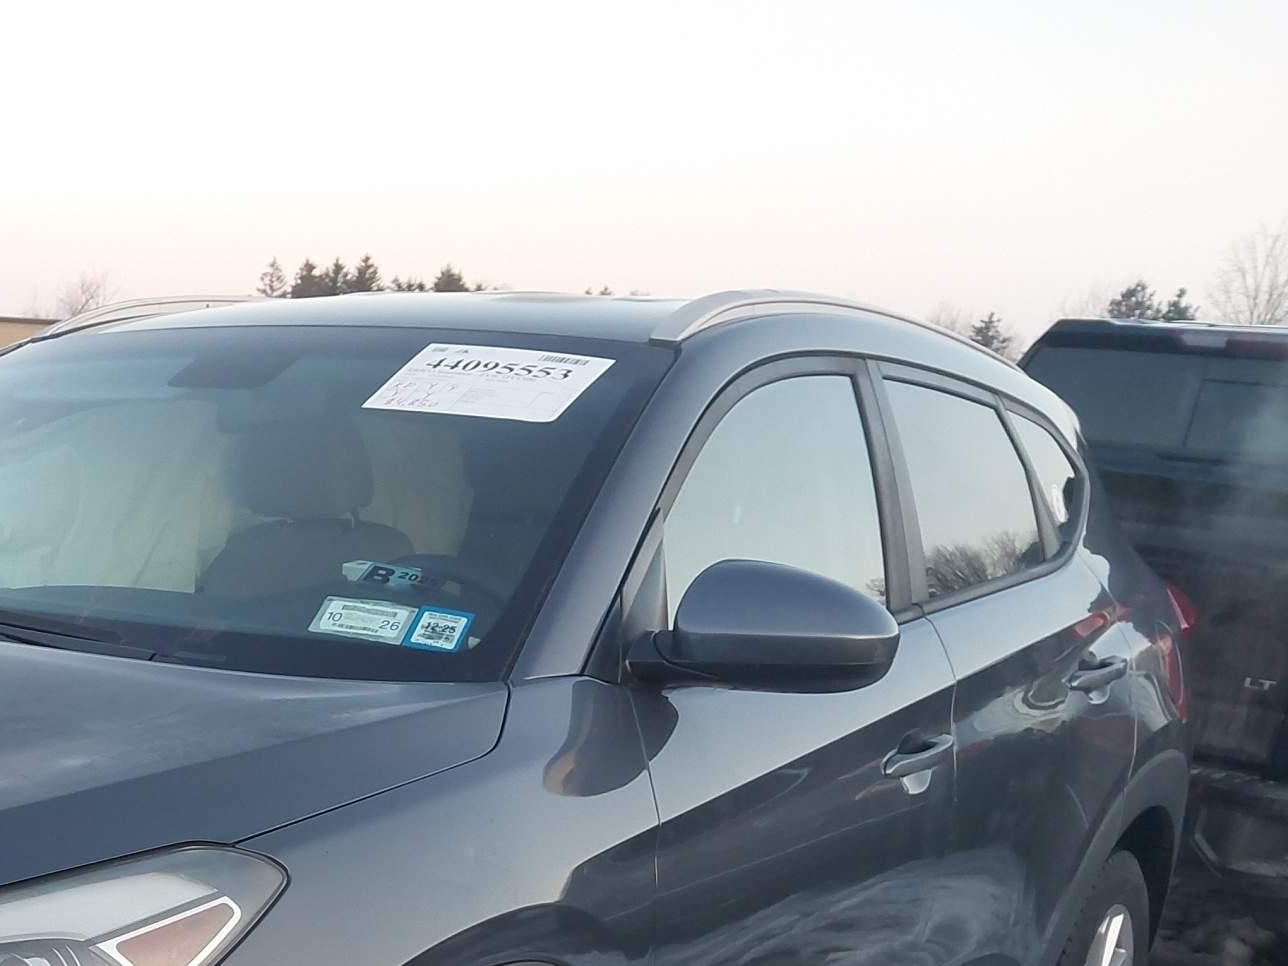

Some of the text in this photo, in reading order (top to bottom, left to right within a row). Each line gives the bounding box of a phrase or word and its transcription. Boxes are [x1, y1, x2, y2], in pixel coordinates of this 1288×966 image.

[426, 357, 573, 380] 44095553
[364, 565, 396, 585] B
[327, 611, 343, 622] 10
[379, 619, 401, 631] 26
[1245, 677, 1277, 691] LT
